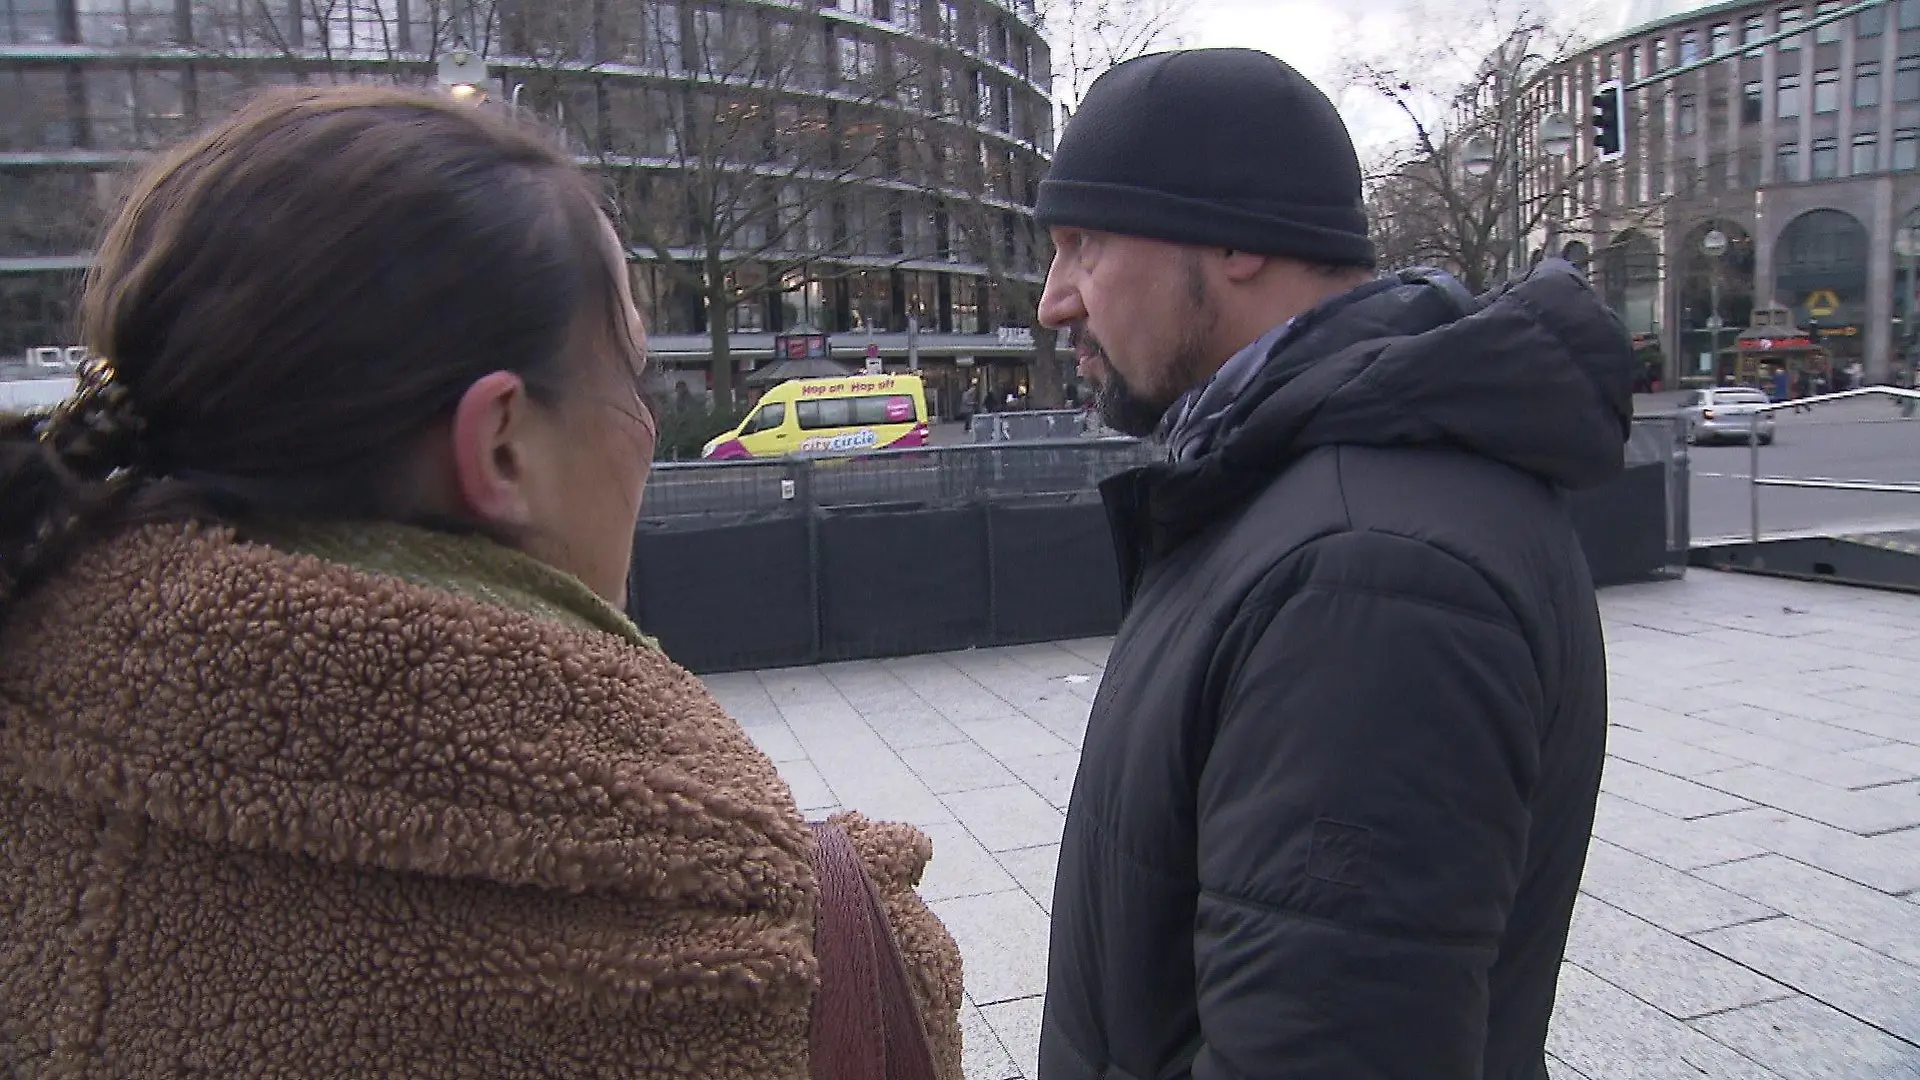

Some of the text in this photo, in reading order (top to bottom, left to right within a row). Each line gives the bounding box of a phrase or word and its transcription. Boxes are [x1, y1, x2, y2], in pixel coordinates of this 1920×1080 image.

[803, 386, 826, 396] Hop
[829, 384, 845, 393] on
[851, 381, 875, 392] Hop
[802, 431, 875, 451] city circle
